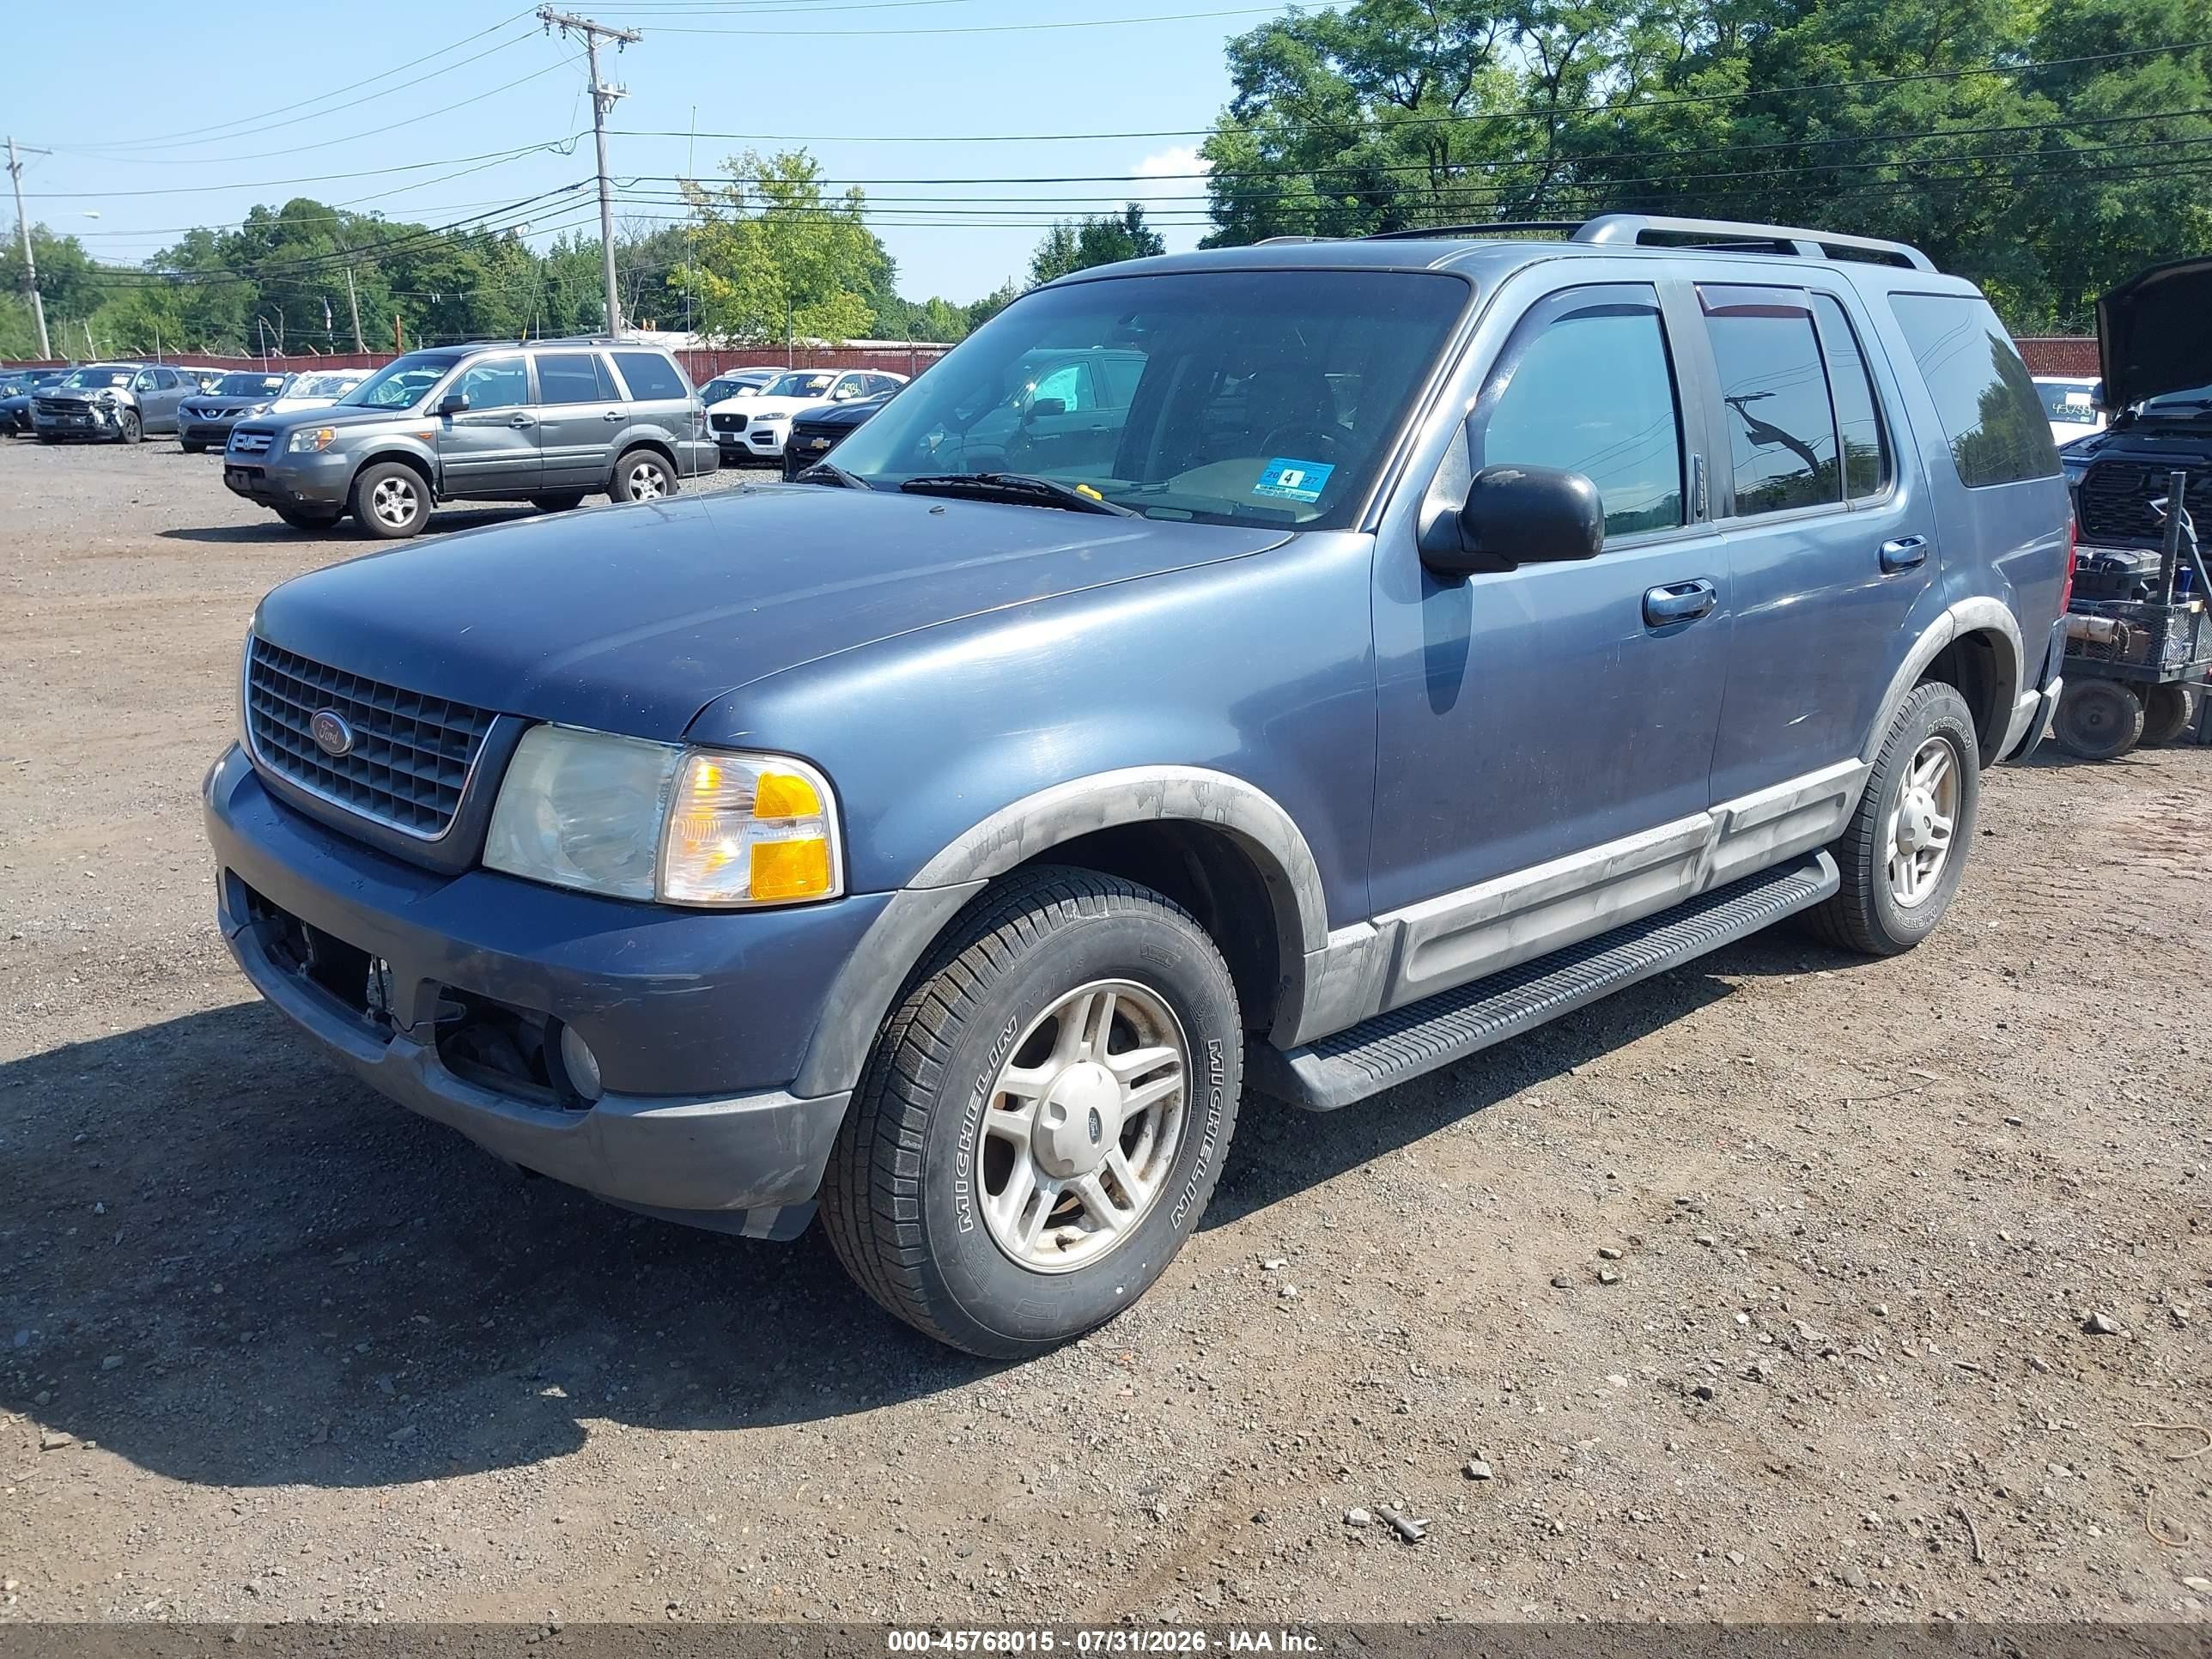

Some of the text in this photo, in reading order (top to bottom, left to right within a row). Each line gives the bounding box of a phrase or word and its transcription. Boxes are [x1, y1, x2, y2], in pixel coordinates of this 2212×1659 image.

[1267, 471, 1319, 484] 20 4 27
[319, 719, 339, 745] Ford
[1923, 715, 1972, 750] MICHELIN
[952, 1014, 1018, 1234] MICHELIN
[1170, 1037, 1224, 1231] MICHELIN
